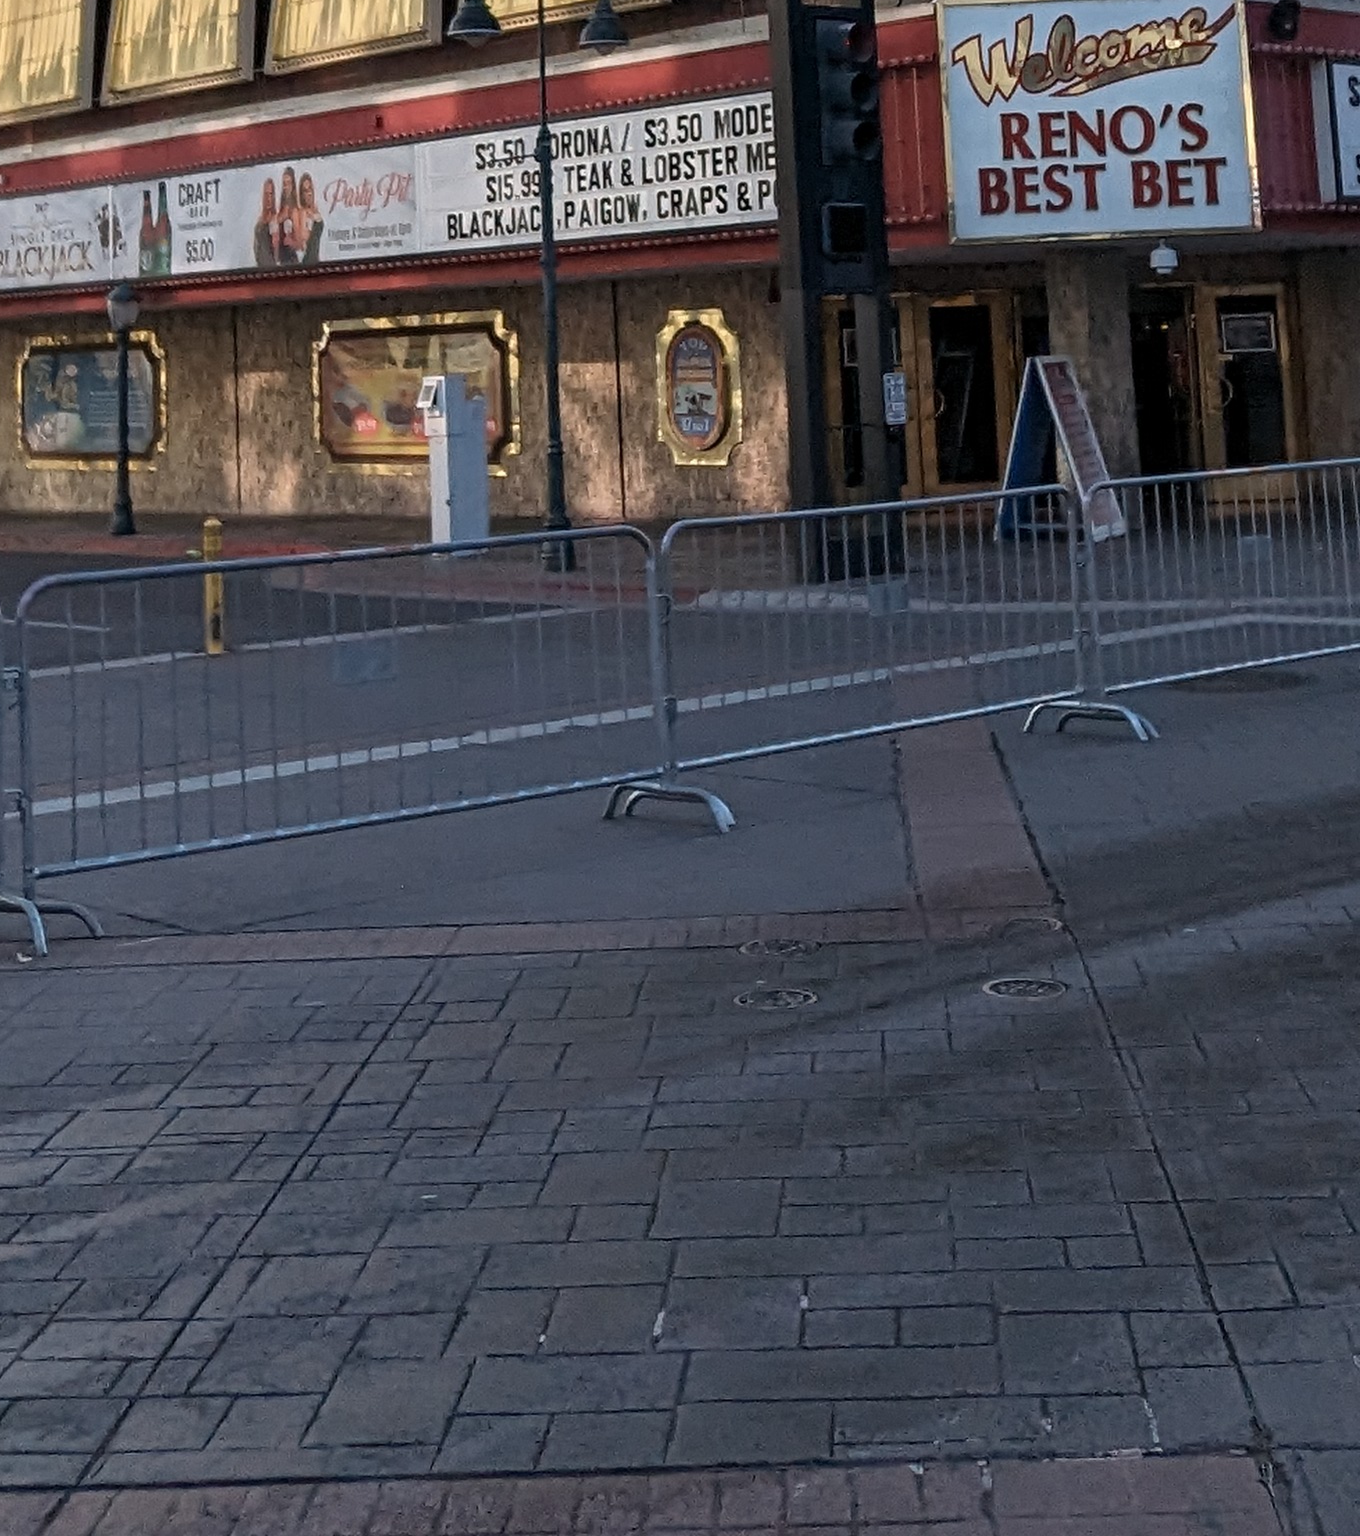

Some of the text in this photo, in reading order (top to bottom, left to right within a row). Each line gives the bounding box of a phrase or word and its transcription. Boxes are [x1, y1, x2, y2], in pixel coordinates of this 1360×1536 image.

[951, 4, 1237, 108] Welcome
[542, 124, 613, 162] ORONA
[620, 122, 631, 152] /
[713, 102, 773, 141] MODE
[999, 102, 1210, 162] RENO'S
[620, 158, 635, 187] &
[641, 144, 739, 185] LOBSTER
[746, 140, 777, 175] ME
[977, 156, 1228, 216] BEST BET
[177, 178, 222, 207] CRAFT
[323, 171, 413, 222] Party Pit
[656, 183, 729, 221] CRAPS
[736, 183, 753, 212] &
